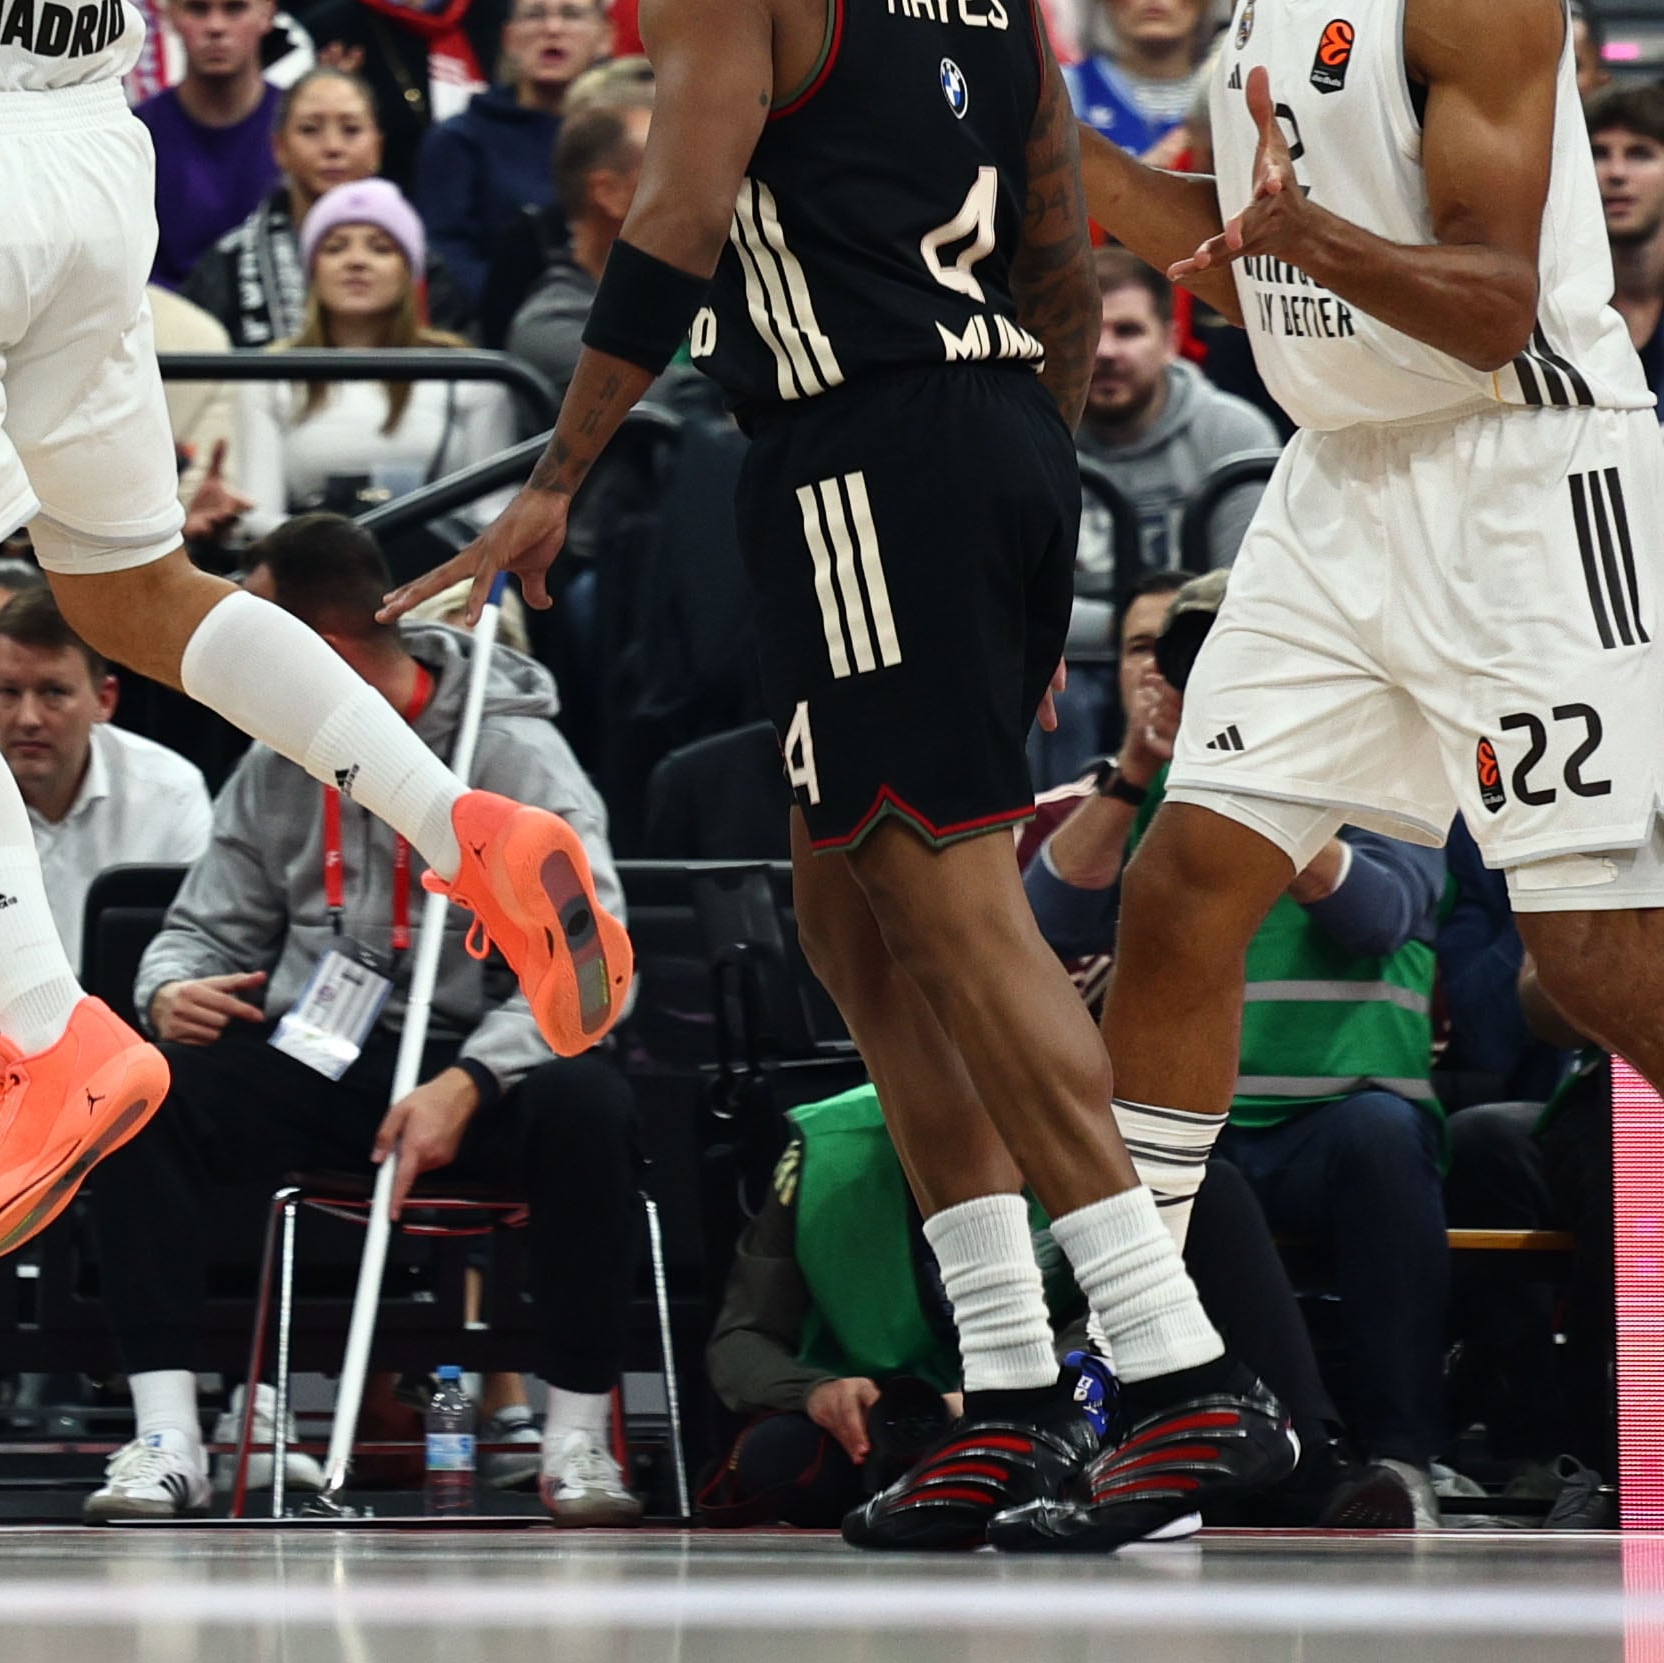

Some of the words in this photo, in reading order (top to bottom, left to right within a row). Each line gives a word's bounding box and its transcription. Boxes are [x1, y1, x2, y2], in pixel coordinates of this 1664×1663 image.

[921, 165, 998, 304] 4
[783, 699, 823, 806] 4
[1499, 702, 1613, 807] 22
